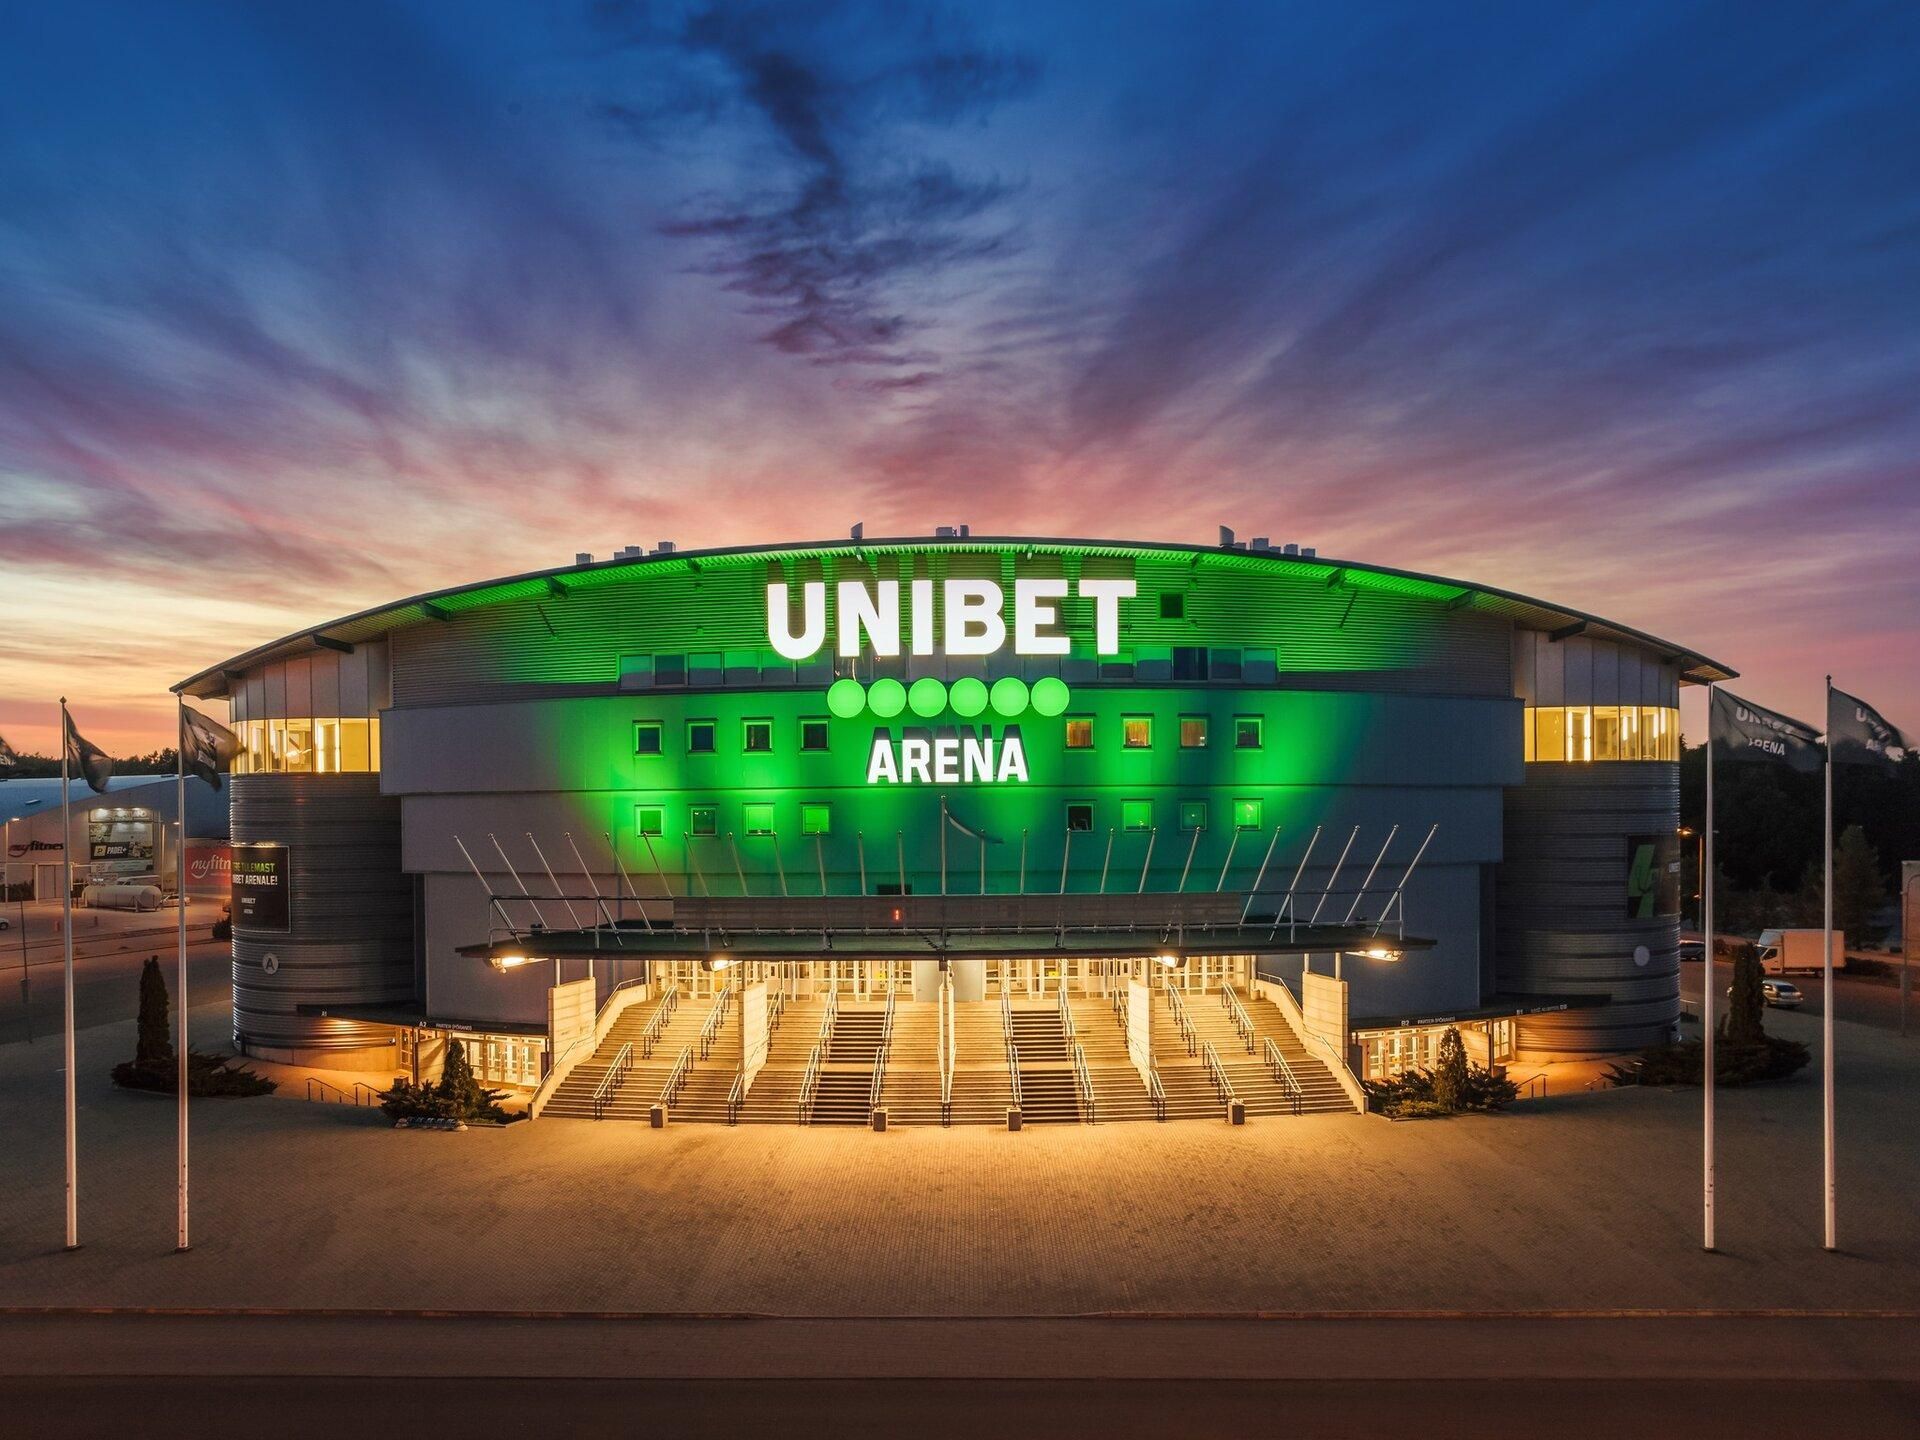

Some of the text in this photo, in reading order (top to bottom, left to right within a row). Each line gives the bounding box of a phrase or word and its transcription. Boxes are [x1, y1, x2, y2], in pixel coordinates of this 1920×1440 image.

[766, 579, 1137, 660] UNIBET
[866, 736, 1030, 784] ARENA
[191, 855, 232, 879] myfitn
[245, 875, 278, 886] ARENALE!
[265, 957, 275, 971] A
